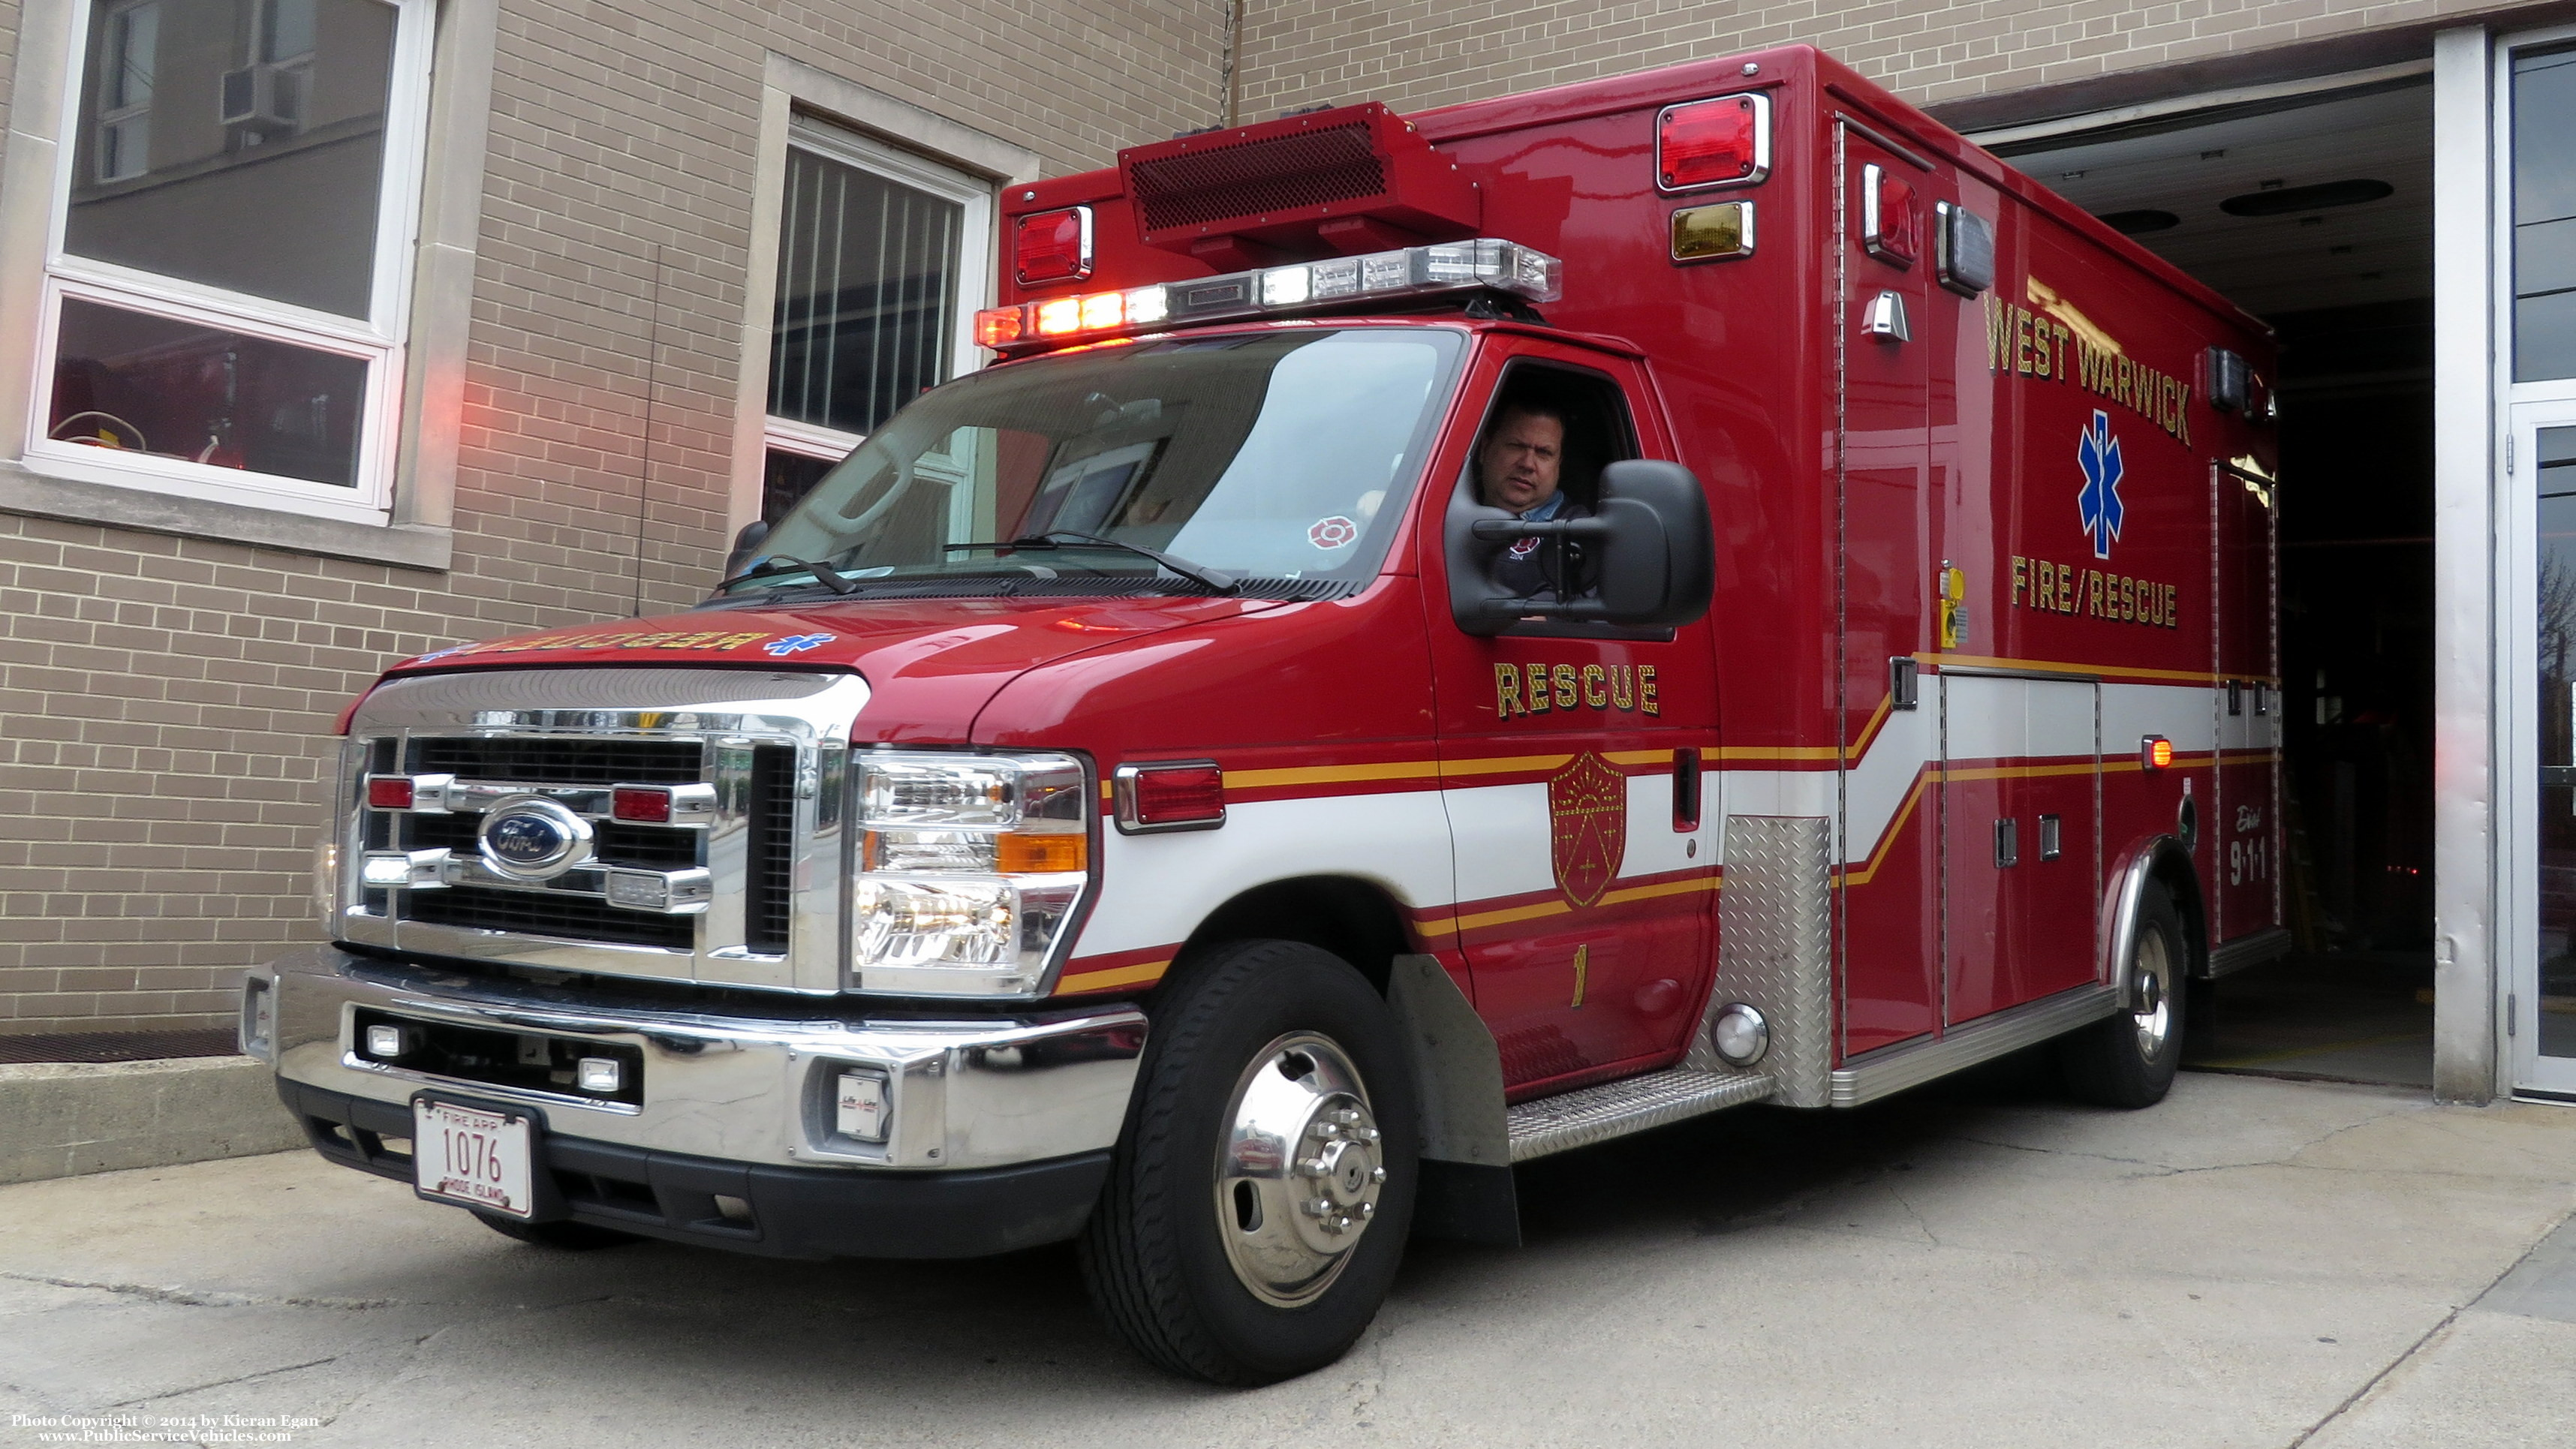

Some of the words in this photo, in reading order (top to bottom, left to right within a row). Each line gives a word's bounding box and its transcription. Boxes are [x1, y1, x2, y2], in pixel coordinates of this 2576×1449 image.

[1983, 291, 2069, 380] WEST
[2075, 332, 2192, 448] WARWICK
[2012, 555, 2176, 627] FIRE/RESCUE
[1494, 662, 1660, 717] RESCUE
[497, 819, 545, 852] Ford
[1571, 943, 1588, 1009] 1
[444, 1127, 502, 1183] 1076
